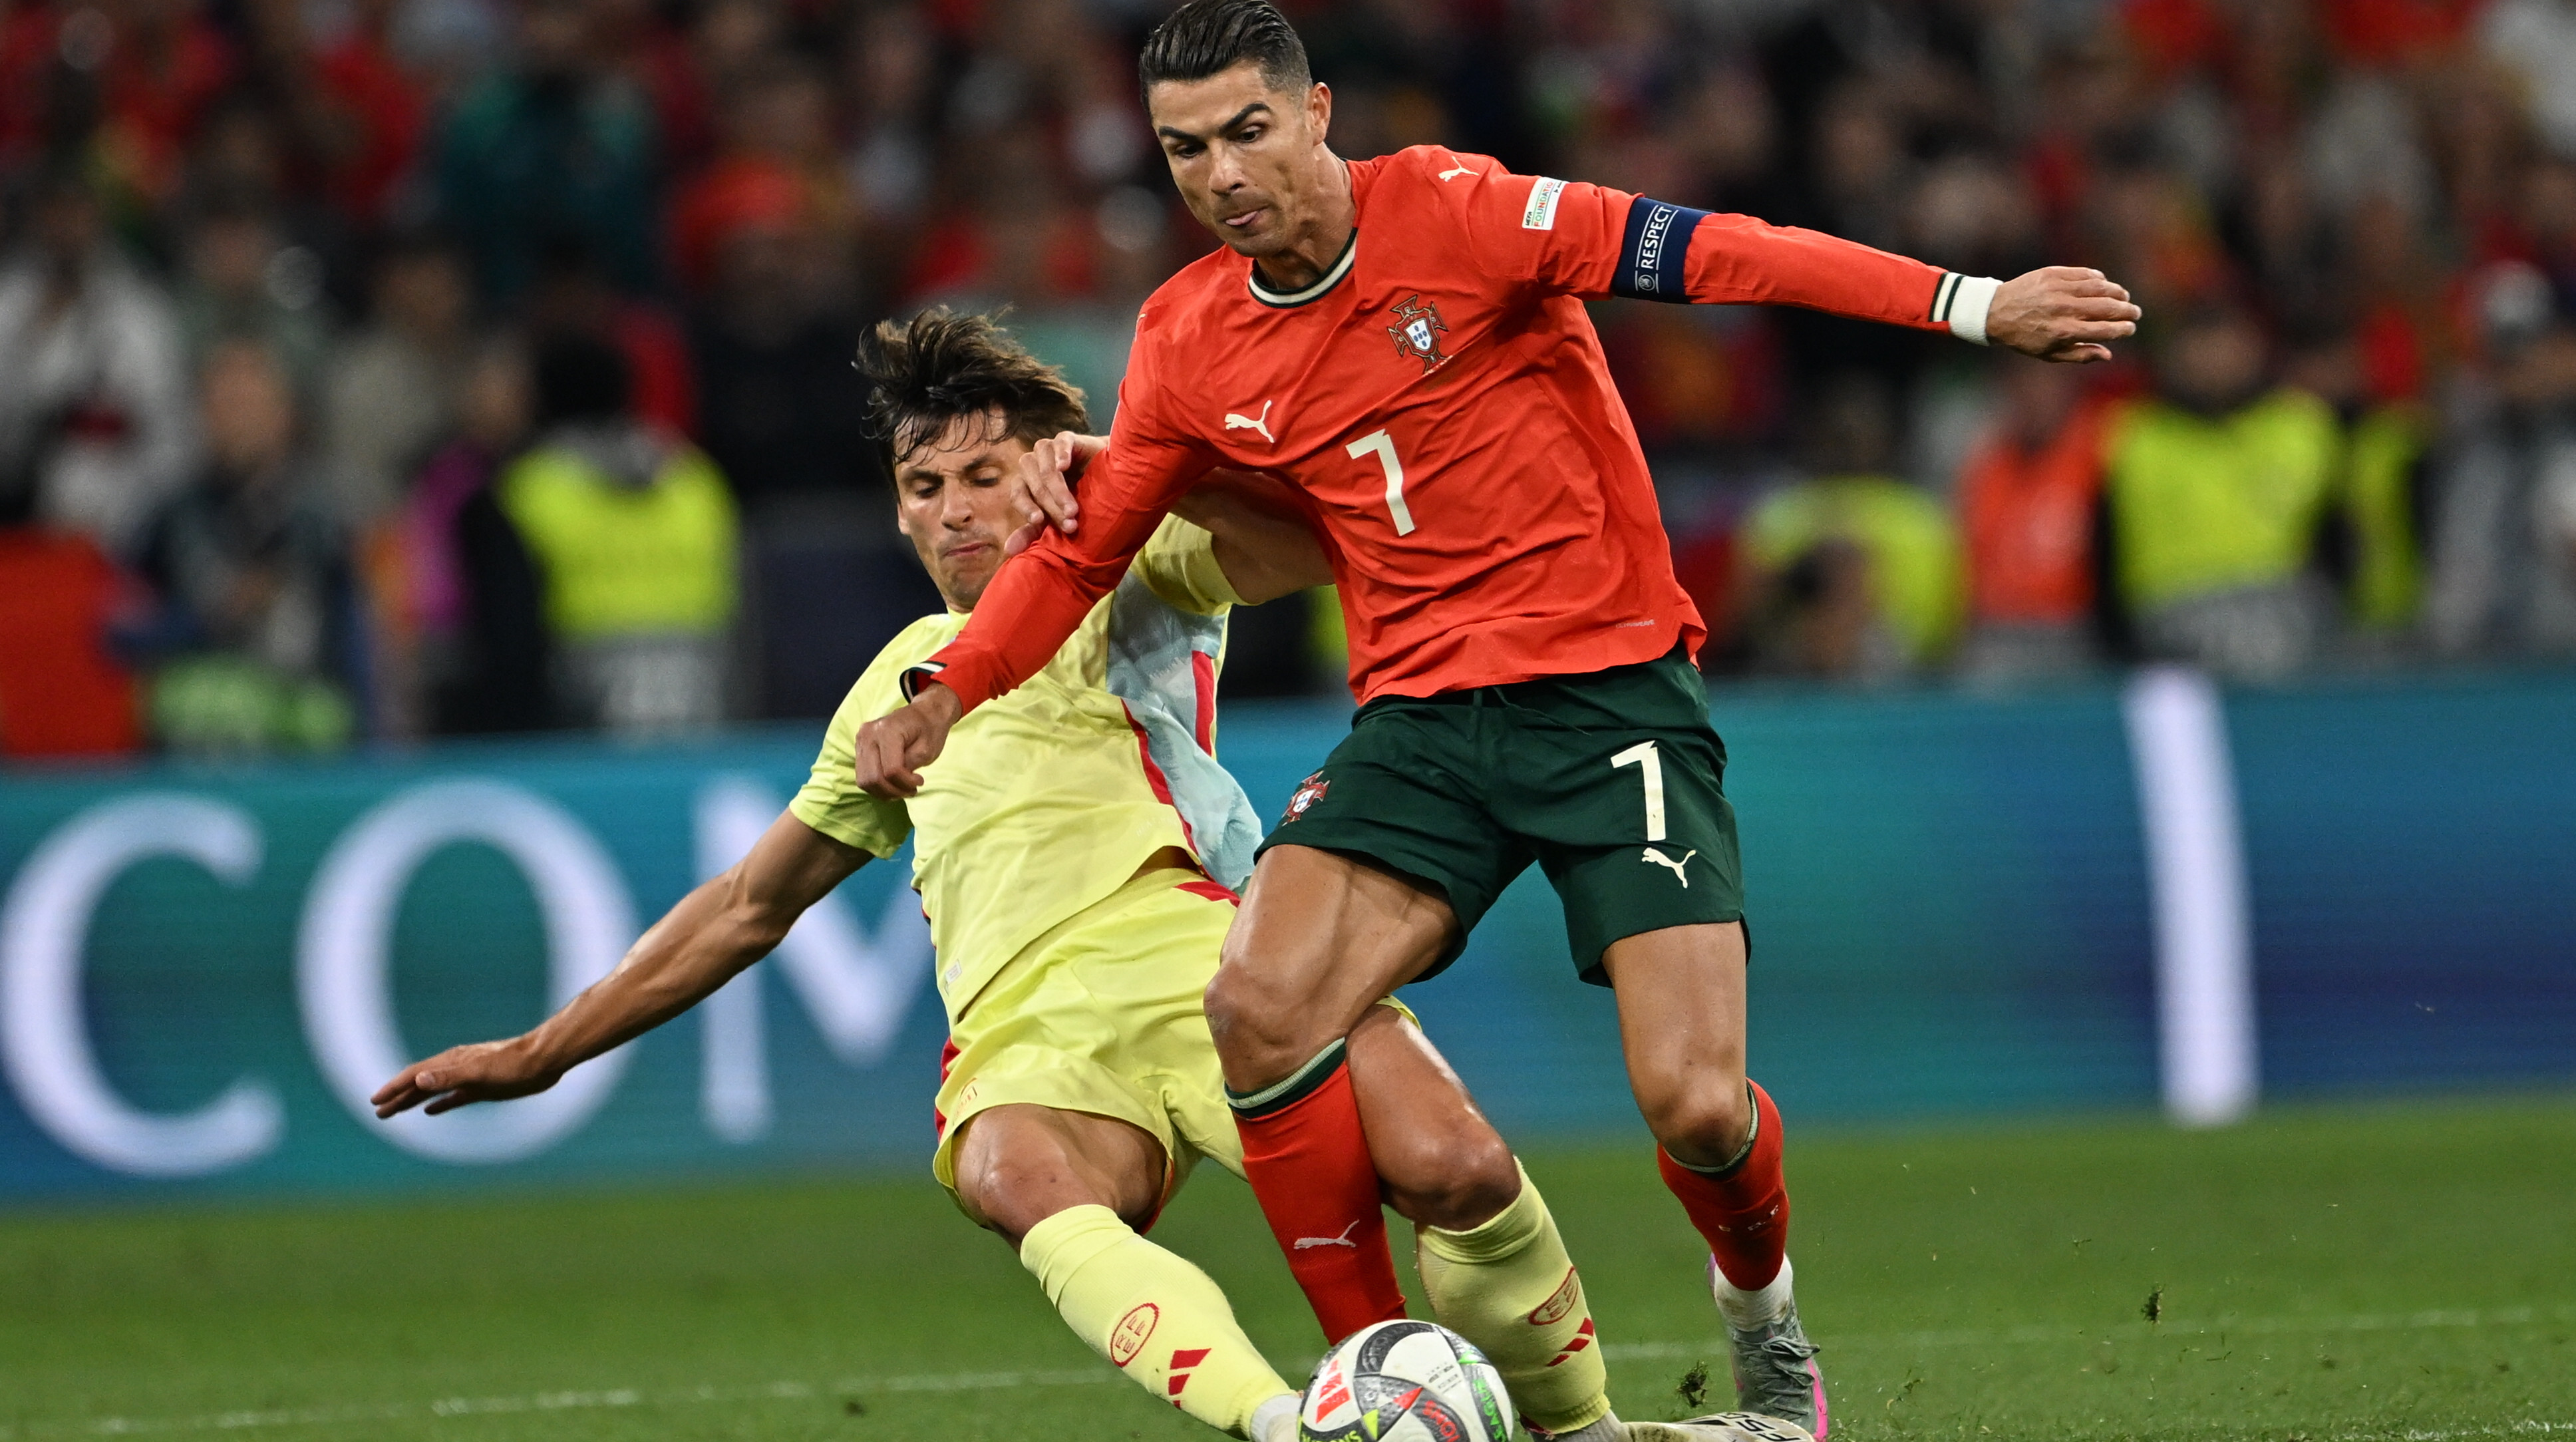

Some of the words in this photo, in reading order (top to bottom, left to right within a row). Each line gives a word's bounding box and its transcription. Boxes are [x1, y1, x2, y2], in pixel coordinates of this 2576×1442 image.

[1533, 180, 1554, 227] FOUNDATIO
[1641, 206, 1673, 270] RESPECT
[1345, 428, 1416, 537] 7
[1610, 740, 1667, 842] 7
